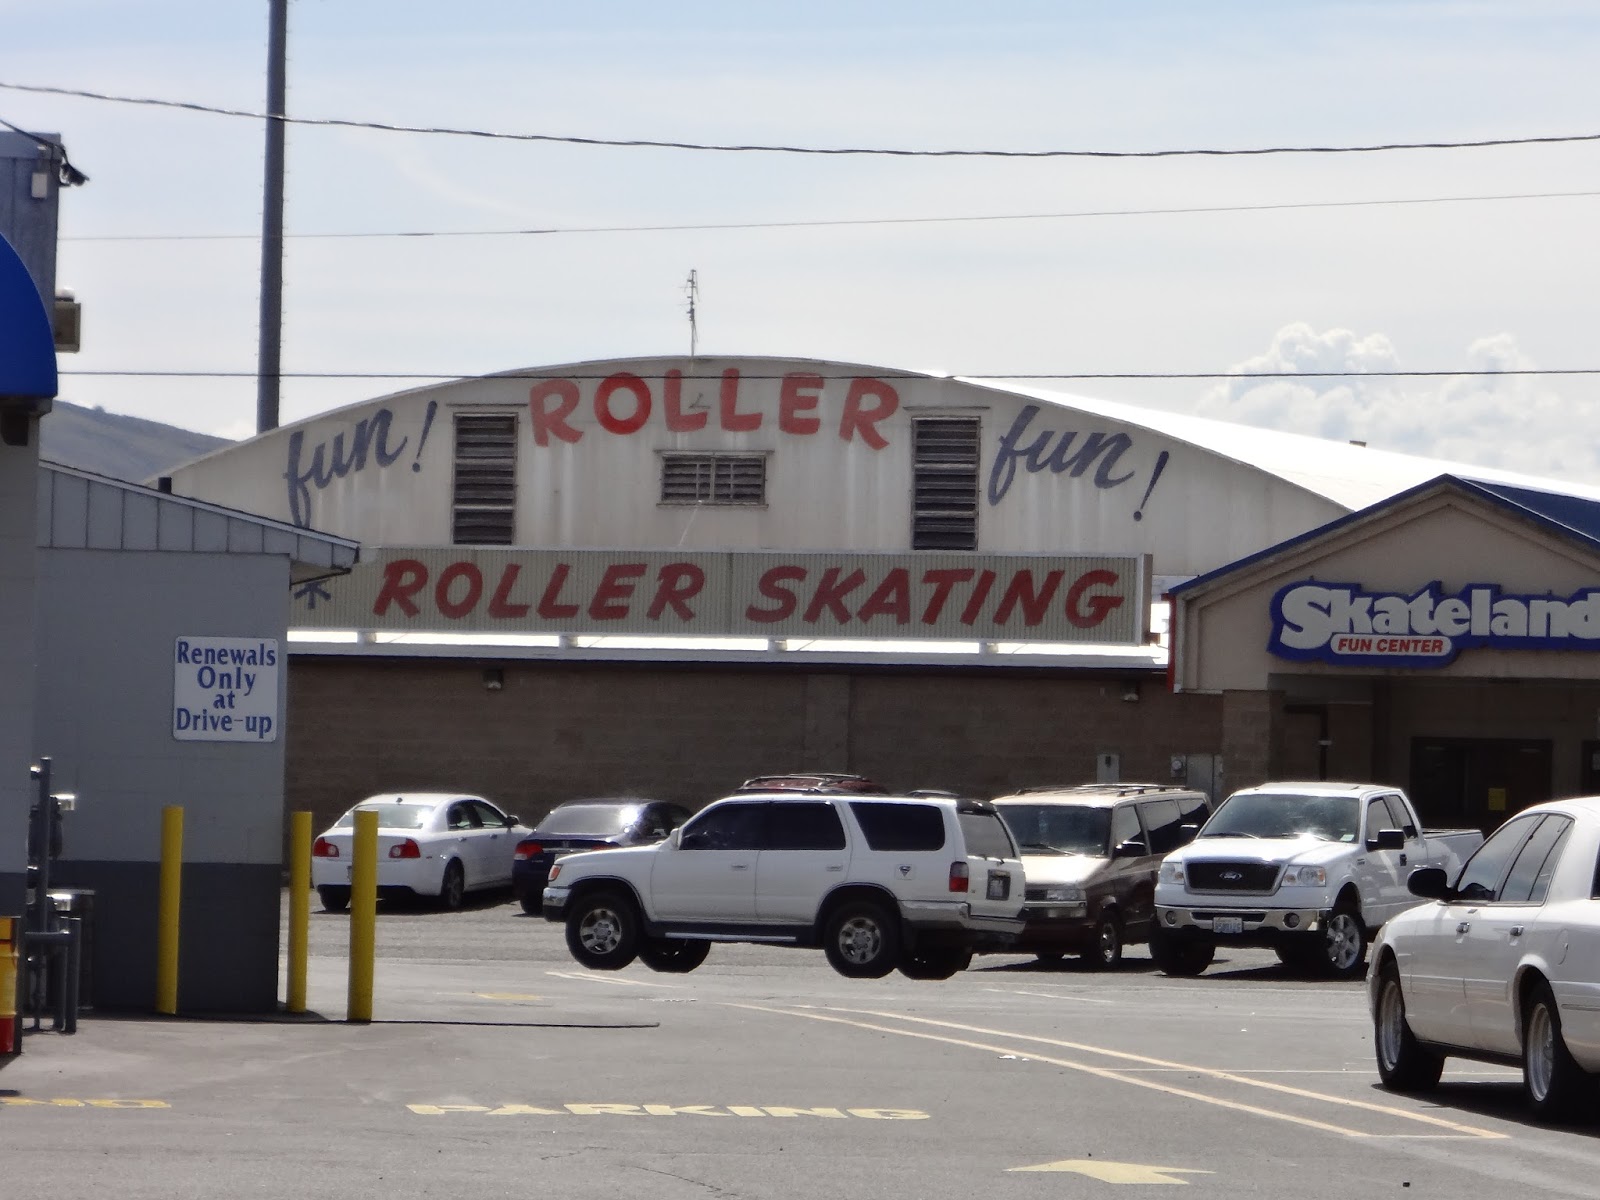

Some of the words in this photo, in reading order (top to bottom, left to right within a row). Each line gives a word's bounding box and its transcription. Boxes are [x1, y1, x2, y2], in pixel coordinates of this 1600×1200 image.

[529, 368, 899, 450] ROLLER
[988, 405, 1169, 521] fun!
[373, 559, 705, 622] ROLLER
[745, 565, 1125, 628] SKATING
[1279, 586, 1600, 650] Skateland
[177, 641, 276, 666] Renewals
[1338, 638, 1372, 652] FUN
[1376, 638, 1444, 653] CENTER
[197, 666, 256, 696] Only
[213, 691, 235, 709] at
[177, 708, 272, 739] Drive-up
[406, 1103, 931, 1119] PARKING
